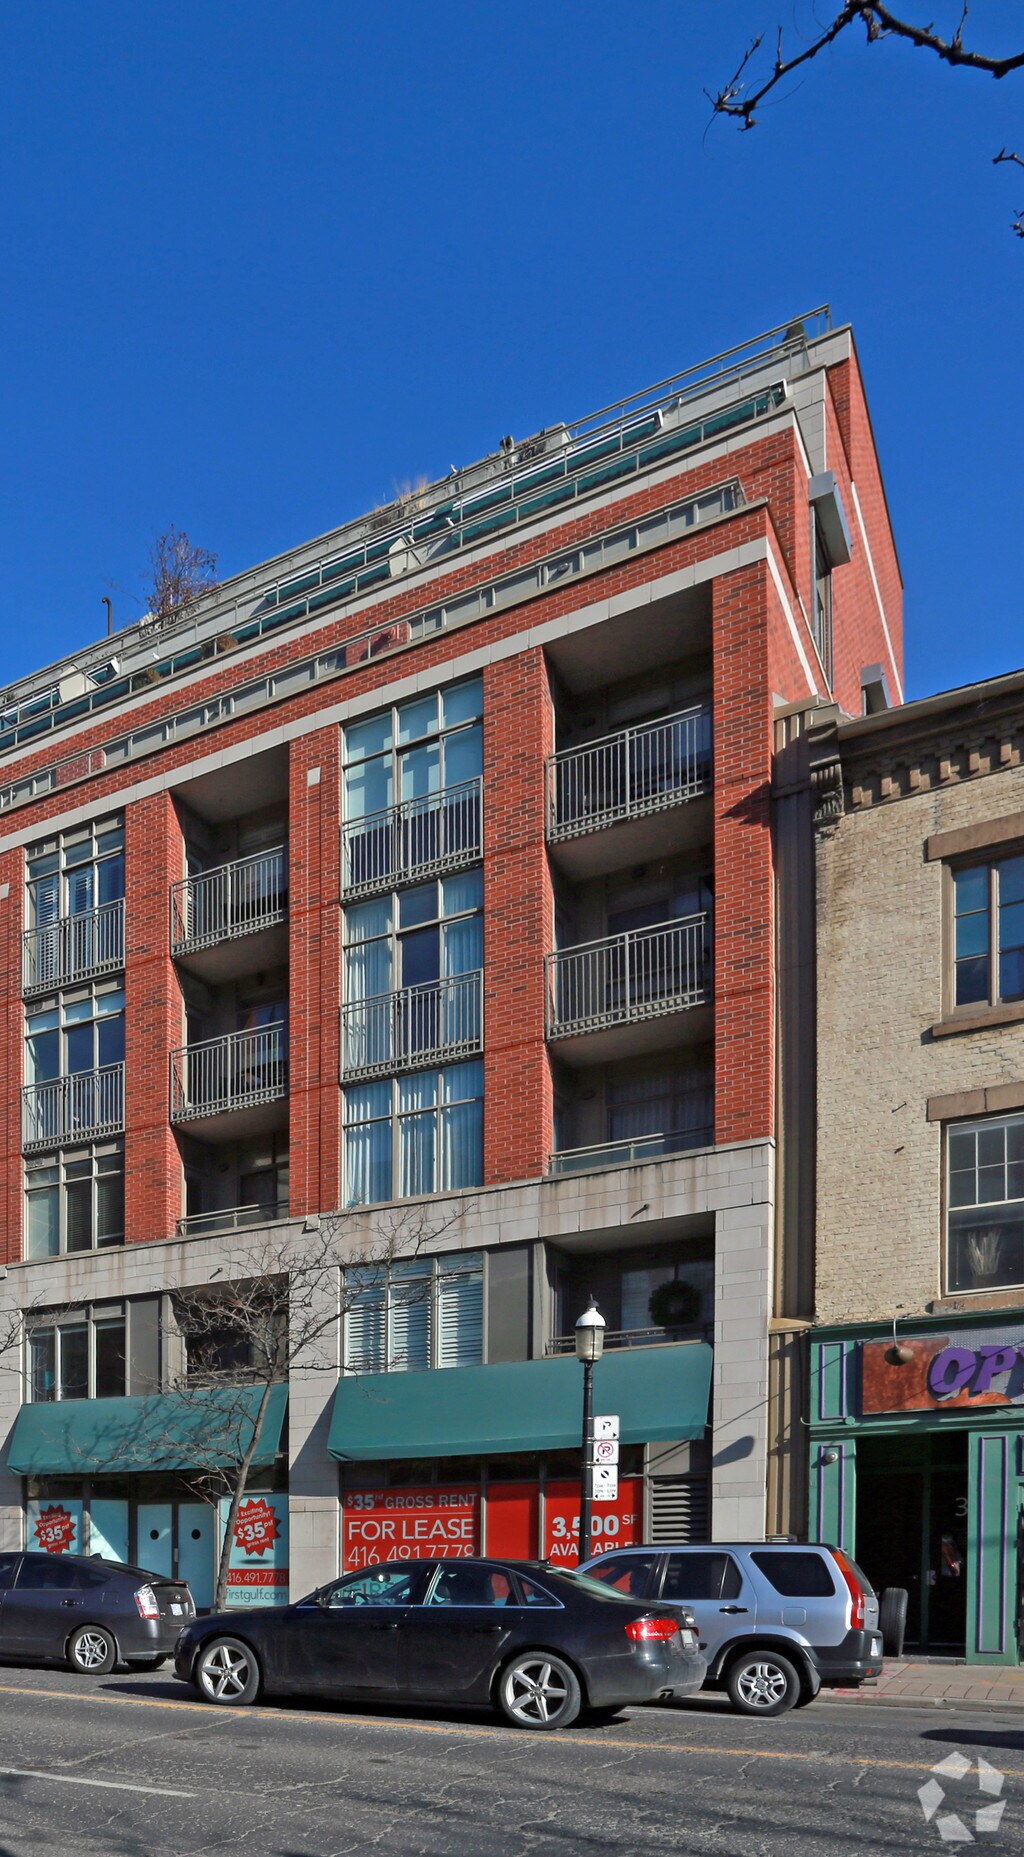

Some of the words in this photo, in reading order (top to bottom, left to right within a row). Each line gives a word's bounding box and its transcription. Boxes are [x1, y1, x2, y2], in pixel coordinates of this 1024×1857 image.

[930, 1345, 1024, 1393] OP
[347, 1494, 375, 1510] $35
[385, 1496, 434, 1509] GROSS
[438, 1493, 478, 1507] RENT
[236, 1511, 271, 1525] Opportunity!
[241, 1507, 263, 1517] Exciting
[622, 1514, 638, 1525] SF
[40, 1525, 63, 1542] $35
[237, 1521, 266, 1541] $35
[348, 1521, 395, 1540] FOR
[402, 1518, 474, 1540] LEASE
[227, 1572, 286, 1583] 416.491.7778
[225, 1587, 287, 1602] firstgulf.com
